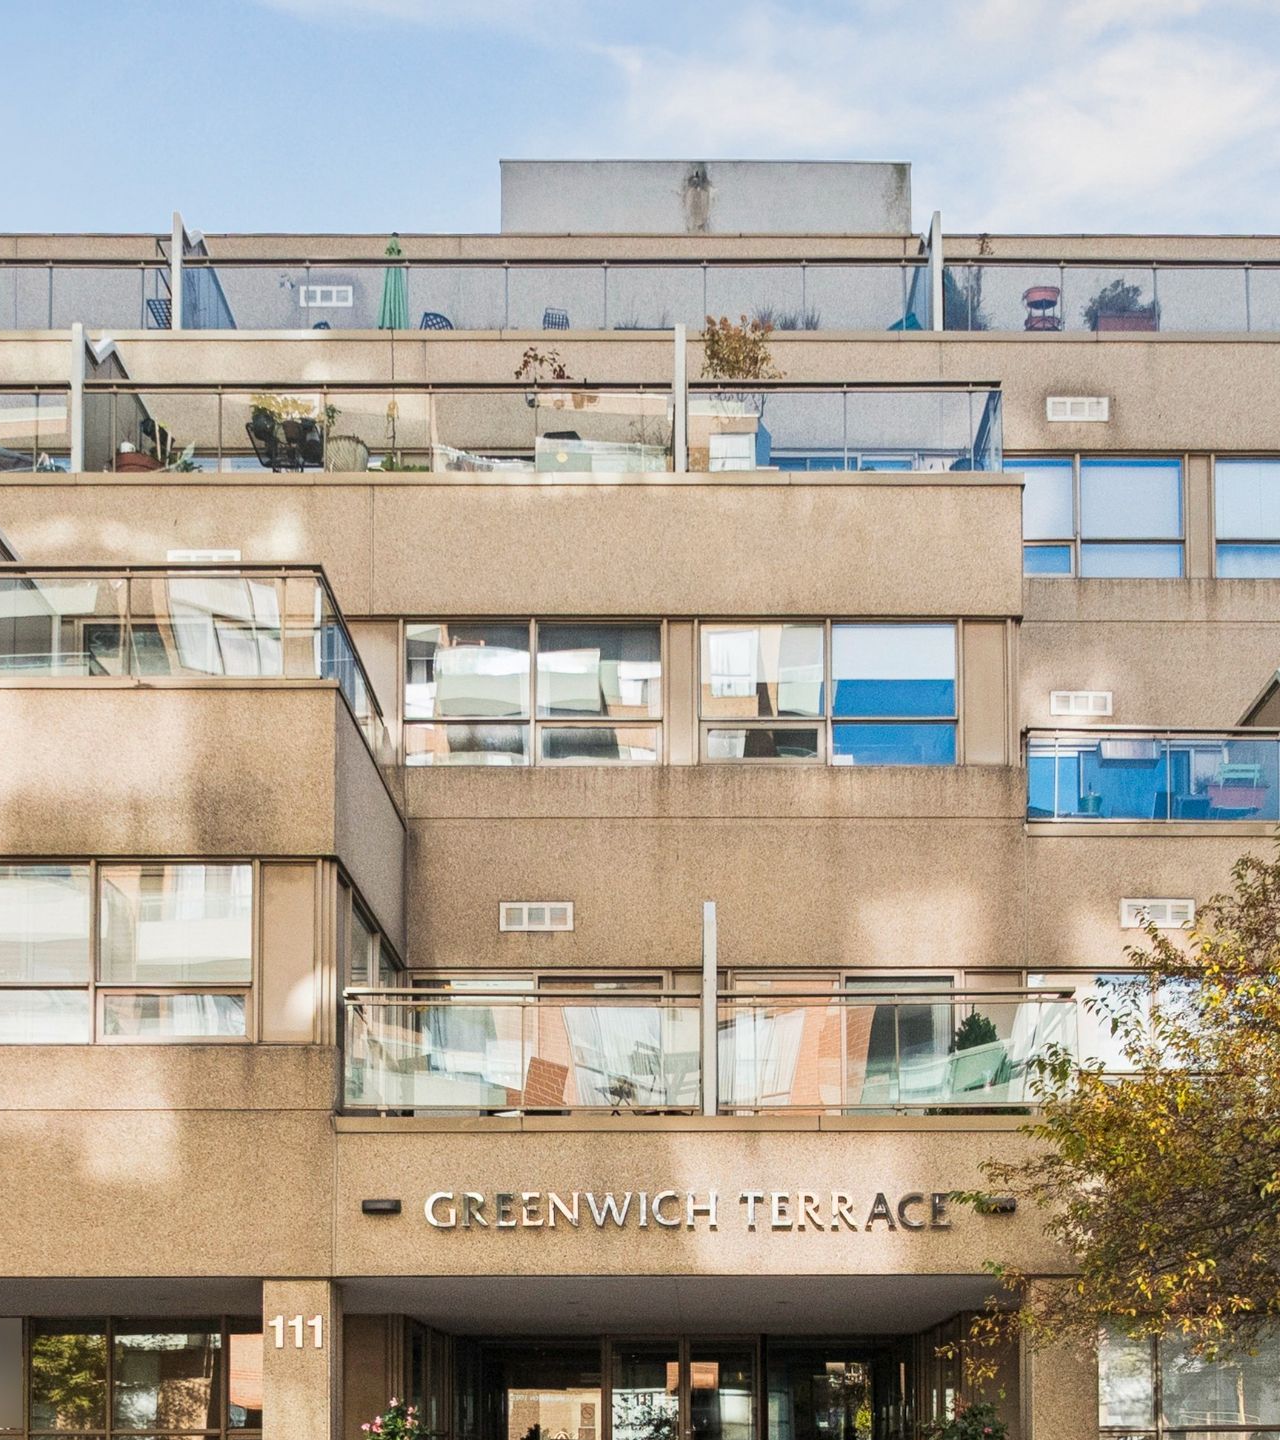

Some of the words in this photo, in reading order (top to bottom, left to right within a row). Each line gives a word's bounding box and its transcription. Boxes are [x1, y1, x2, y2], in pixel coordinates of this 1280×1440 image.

[423, 1190, 719, 1230] GREENWICH
[739, 1191, 952, 1231] TERRACE
[268, 1314, 323, 1349] 111
